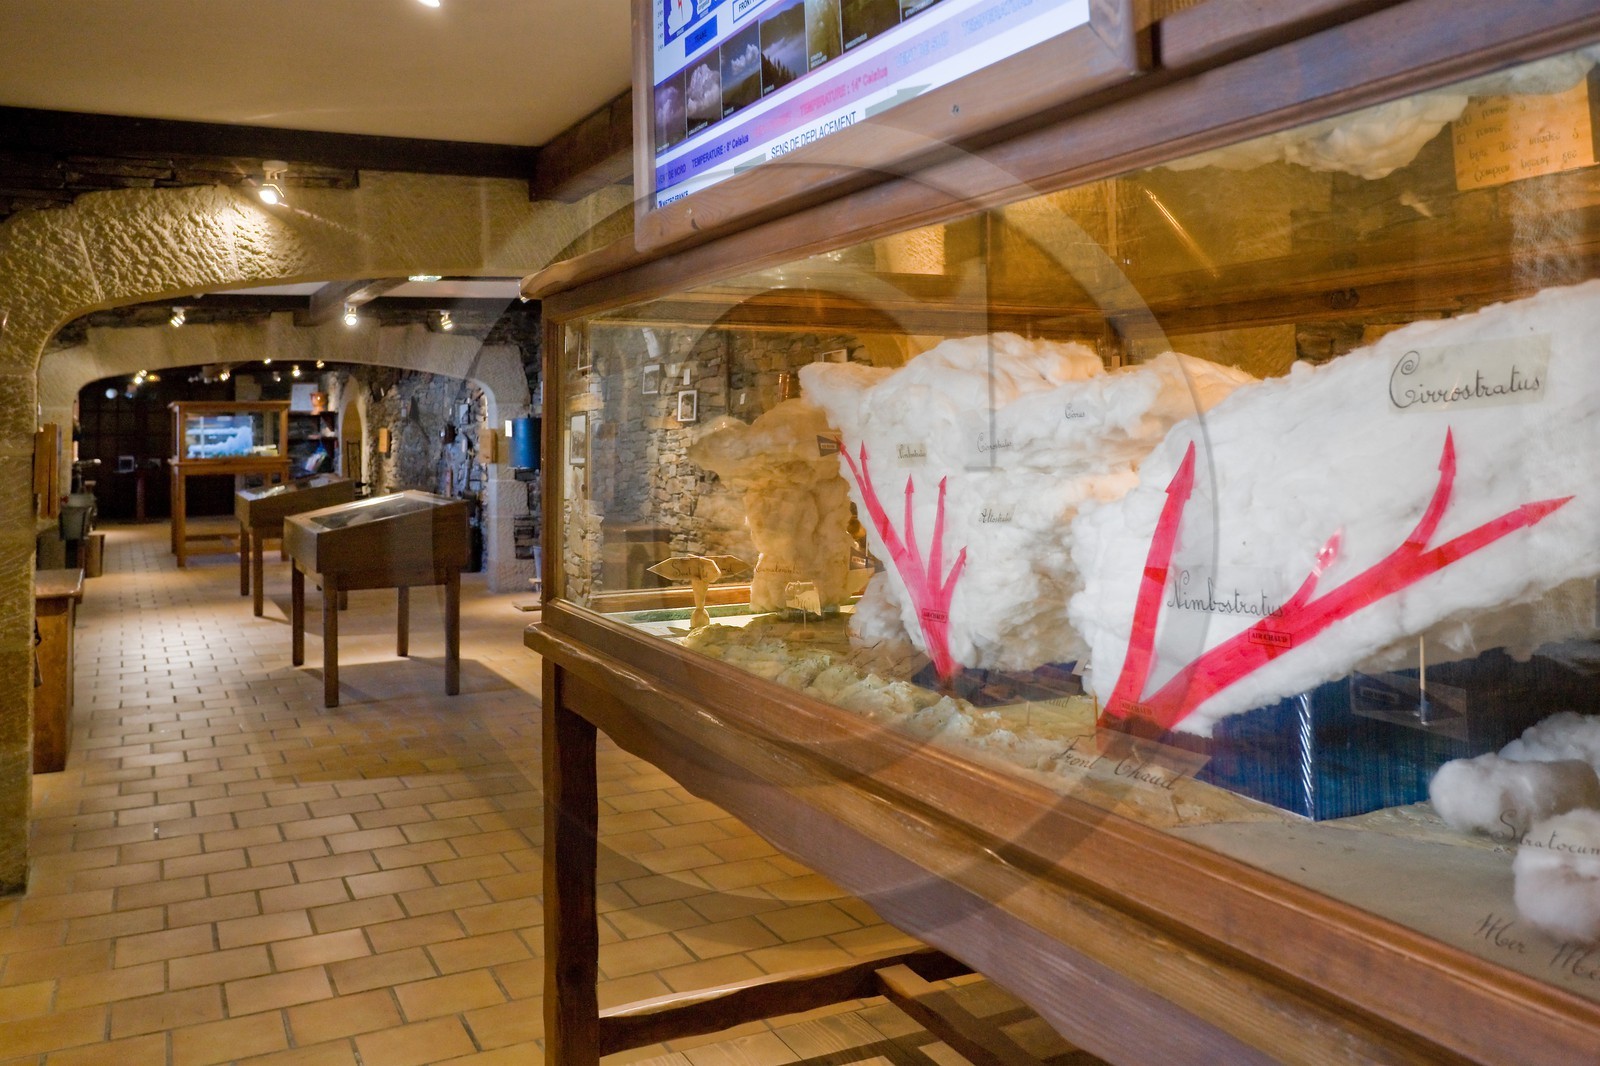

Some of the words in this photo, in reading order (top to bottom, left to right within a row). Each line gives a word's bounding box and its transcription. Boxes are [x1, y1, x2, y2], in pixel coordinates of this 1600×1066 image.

[691, 145, 724, 168] TEMPERATURE
[731, 134, 750, 149] Celsius
[771, 141, 789, 159] SENS
[789, 136, 800, 152] DE
[800, 110, 857, 147] DEPLACEMENT
[1389, 350, 1540, 408] Cirrostratus
[1167, 570, 1284, 618] Nimbostratus
[1251, 632, 1263, 640] AIR
[1263, 632, 1289, 643] CHAUD
[1114, 758, 1184, 791] Chaud
